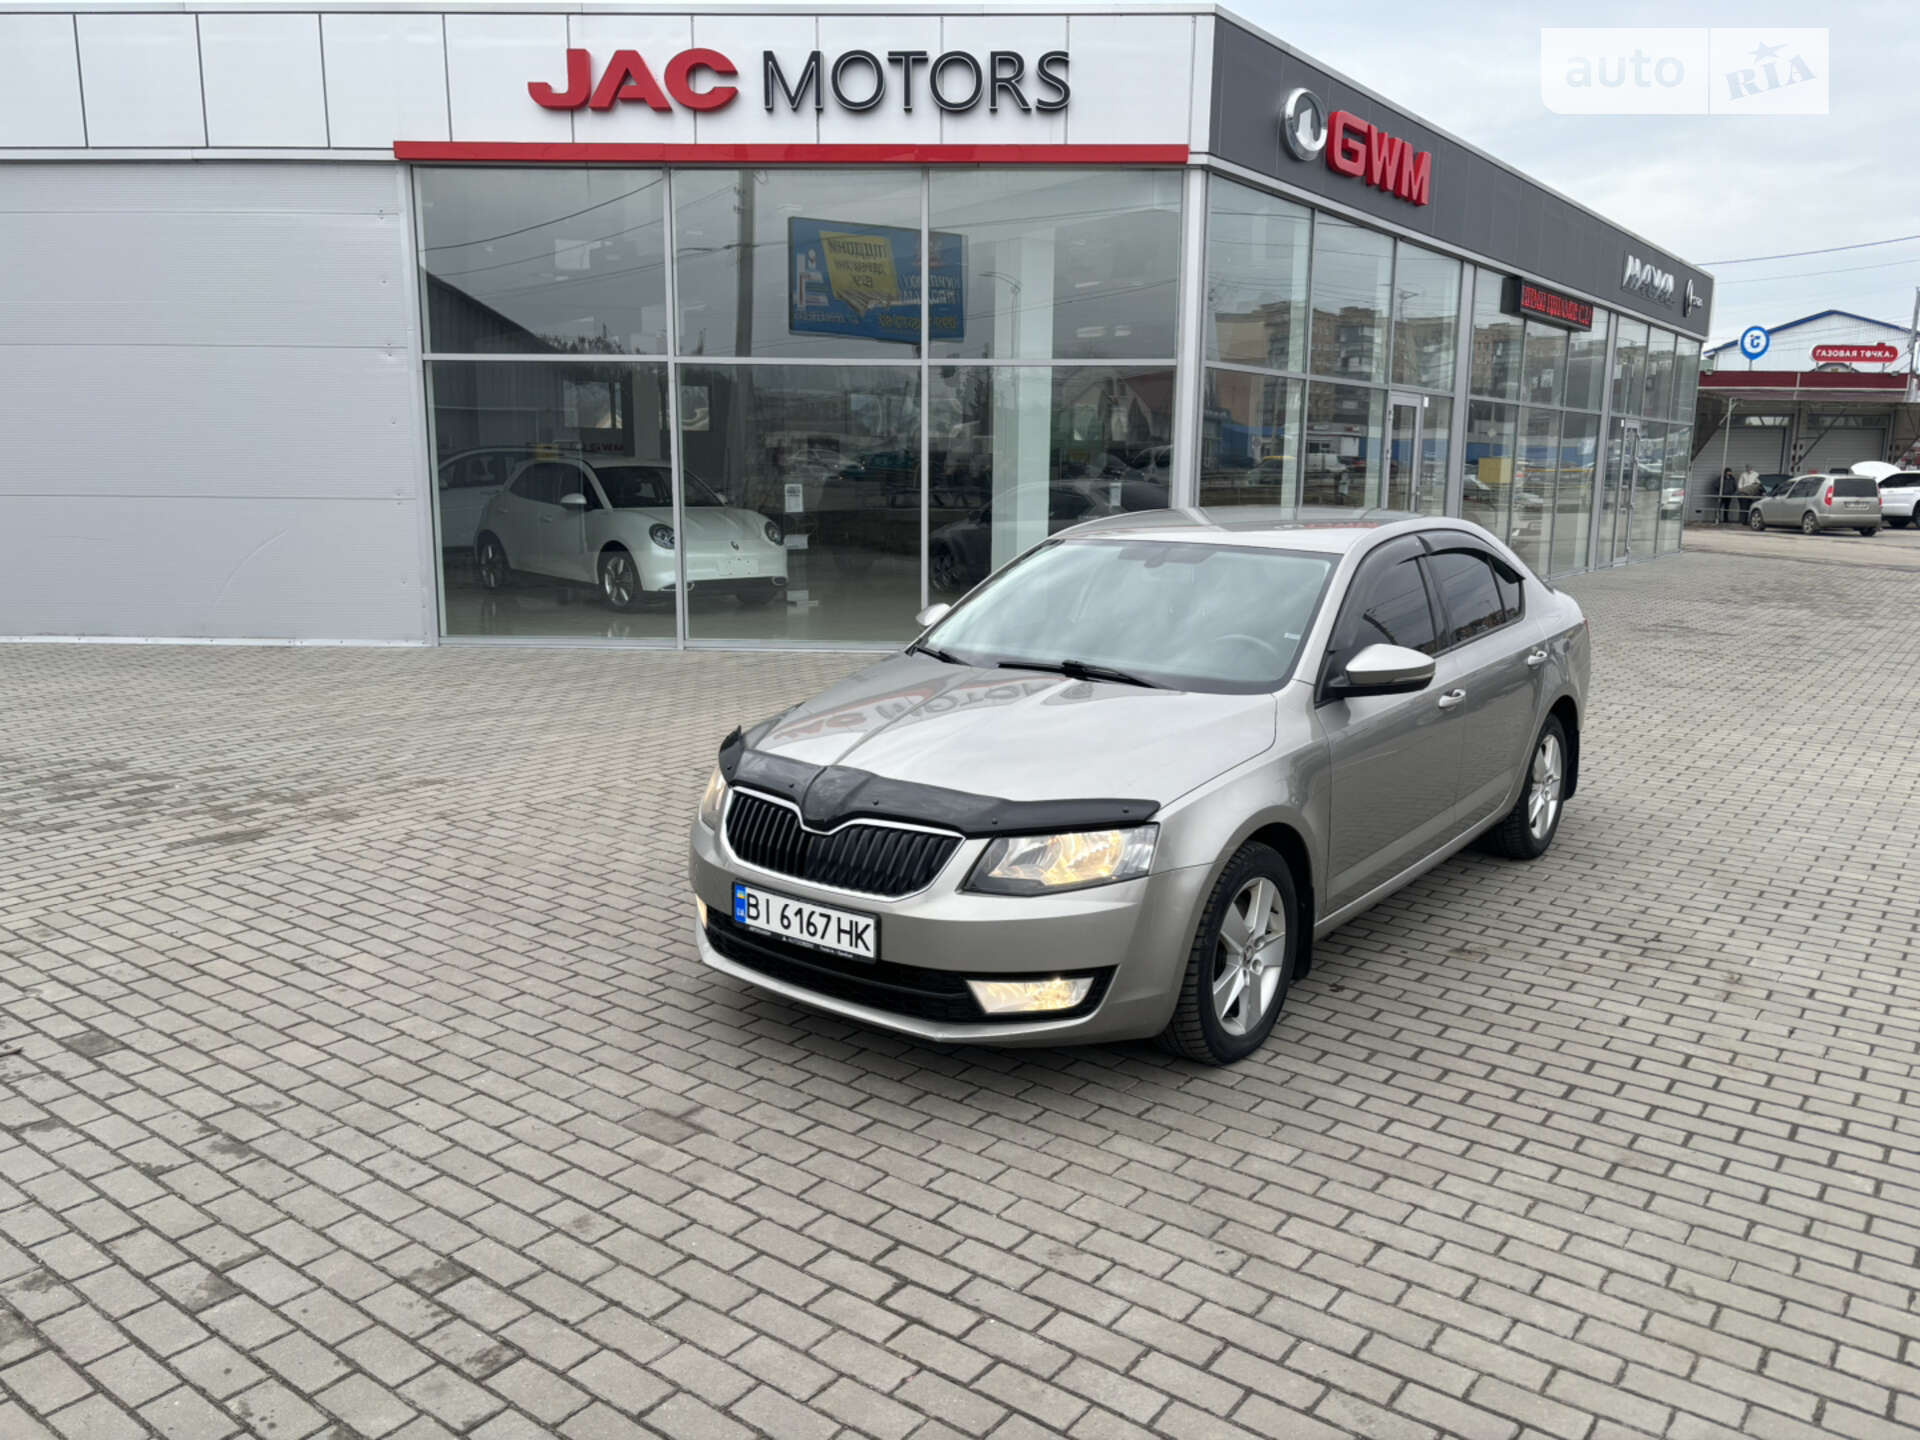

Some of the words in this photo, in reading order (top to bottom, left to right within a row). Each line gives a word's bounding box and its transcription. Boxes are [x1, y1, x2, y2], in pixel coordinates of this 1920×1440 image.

[527, 48, 738, 113] JAC
[762, 50, 1072, 113] MOTORS
[1327, 110, 1432, 207] GWM
[1815, 349, 1858, 358] ГАЗОВАЯ
[747, 893, 770, 925] BI
[780, 903, 832, 940] 6167
[837, 917, 871, 952] HK
